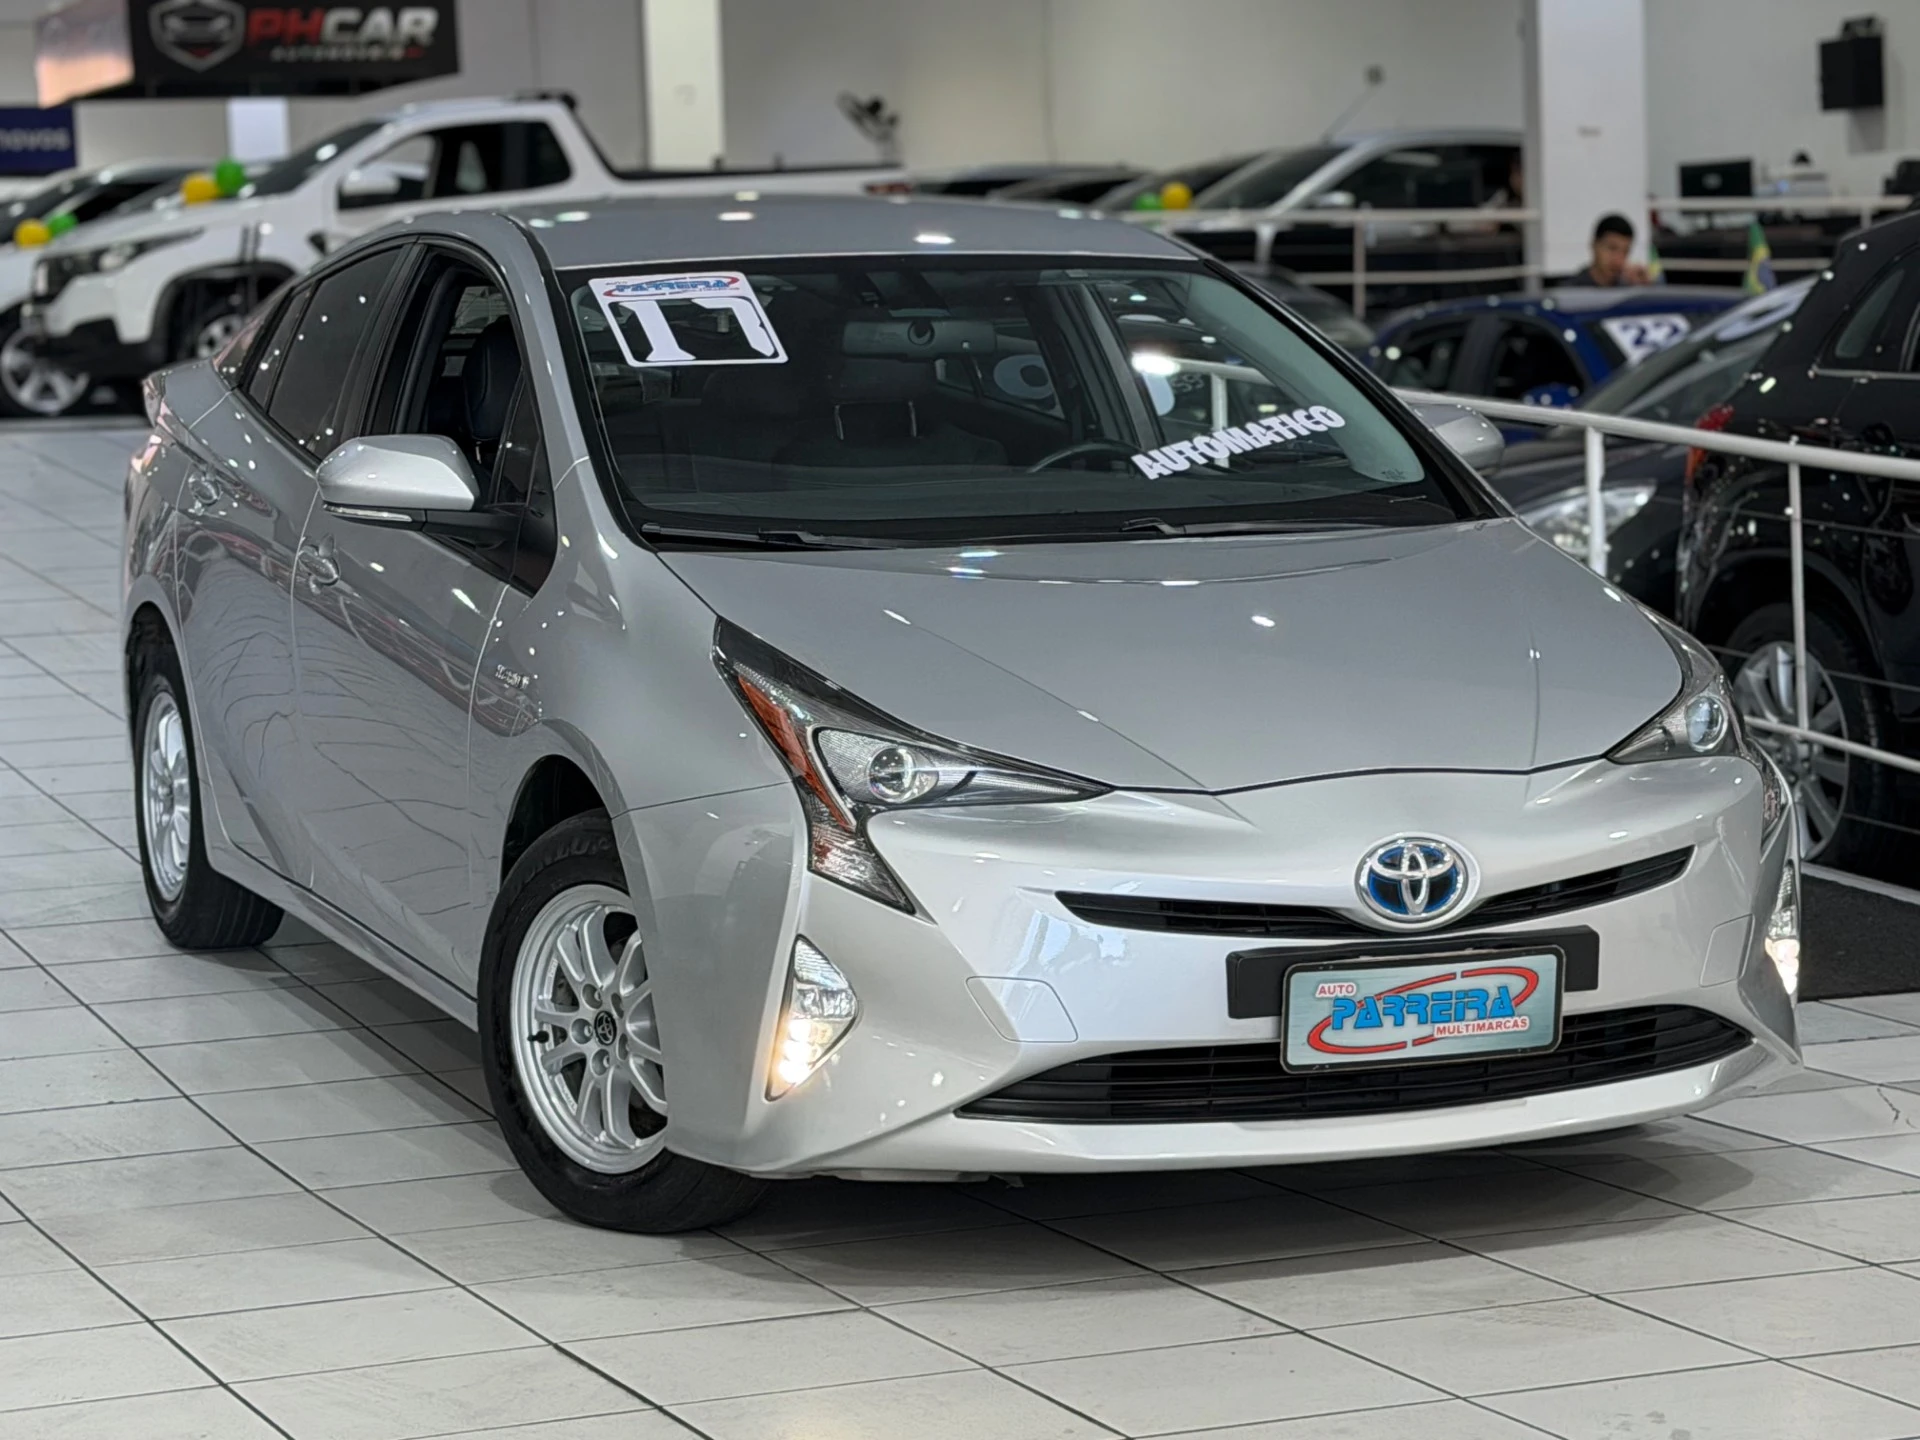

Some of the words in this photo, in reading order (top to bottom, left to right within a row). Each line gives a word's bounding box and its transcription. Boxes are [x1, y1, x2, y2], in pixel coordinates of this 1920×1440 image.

[248, 7, 438, 46] PHCAR
[618, 298, 774, 361] 17
[1131, 405, 1346, 480] AUTOMATICO
[1318, 984, 1355, 997] AUTO
[1331, 985, 1516, 1031] PARREIRA
[1435, 1018, 1529, 1037] MULTIMARCAS
